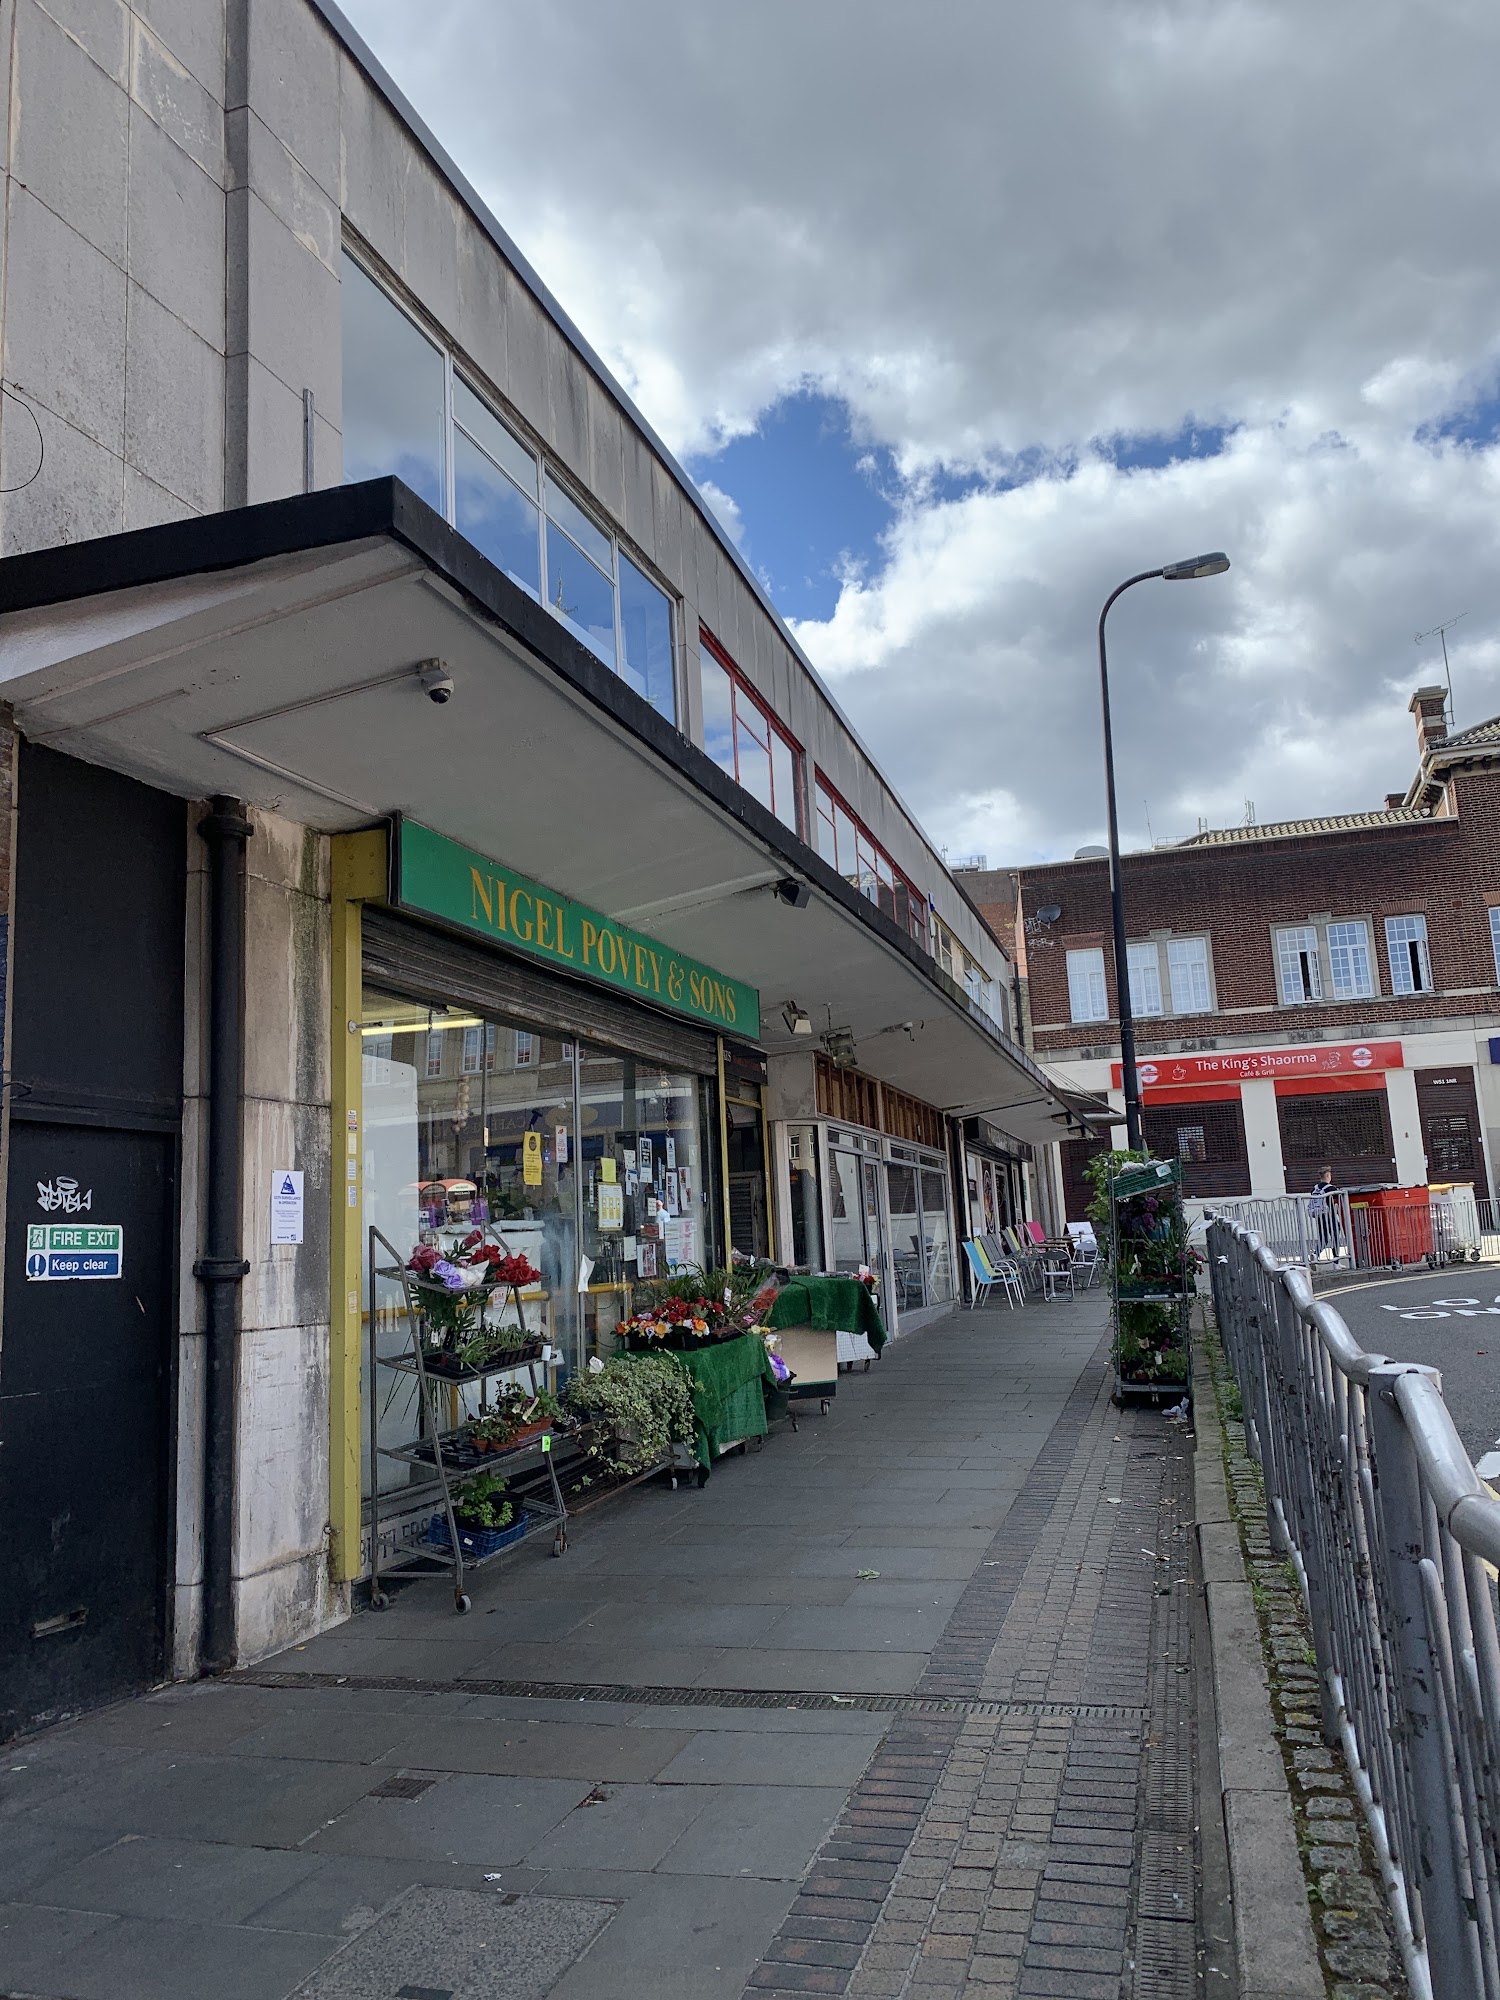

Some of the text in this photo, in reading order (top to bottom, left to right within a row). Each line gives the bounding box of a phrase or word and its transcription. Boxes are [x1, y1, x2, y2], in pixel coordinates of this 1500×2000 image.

[470, 866, 737, 1024] NIGEL POVEY & SONS
[1195, 1053, 1318, 1072] The King's Shaorma
[1239, 1070, 1254, 1078] Café
[1261, 1069, 1275, 1077] Grill
[52, 1231, 116, 1246] FIRE EXIT
[52, 1259, 109, 1273] Keep clear
